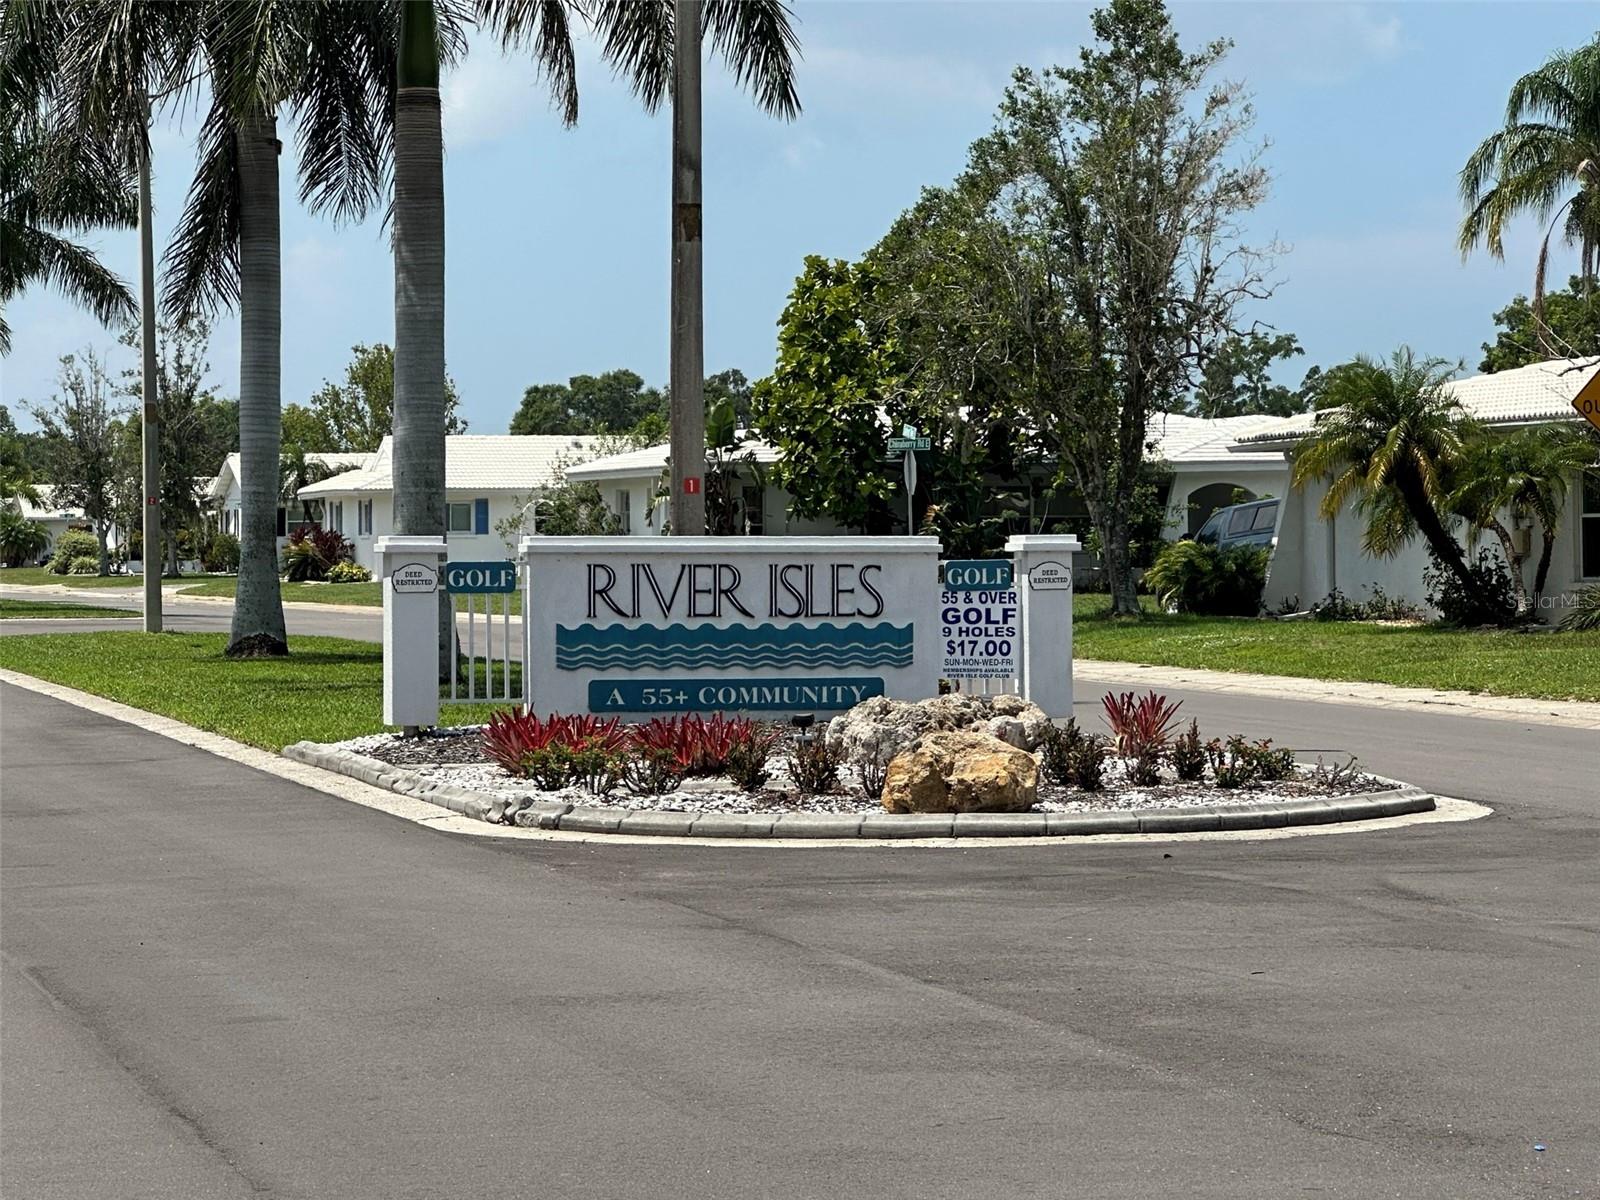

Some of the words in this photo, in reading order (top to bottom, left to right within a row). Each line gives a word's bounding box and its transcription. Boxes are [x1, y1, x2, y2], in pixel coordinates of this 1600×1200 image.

[689, 479, 694, 493] 1
[404, 571, 423, 579] DEED
[448, 569, 514, 587] GOLF
[947, 567, 1009, 585] GOLF
[1033, 576, 1069, 584] RESTRICTED
[586, 563, 755, 619] RIVER
[768, 563, 884, 618] ISLES
[941, 591, 959, 604] 55
[963, 591, 974, 604] &
[978, 591, 1017, 604] OVER
[941, 607, 1017, 625] GOLF
[942, 626, 952, 637] 9
[958, 626, 1016, 637] HOLES
[946, 639, 1012, 657] $17.00
[944, 658, 1014, 666] SUN-MON-WED-FRI
[605, 687, 626, 705] A
[641, 688, 689, 705] 55+
[698, 685, 867, 704] COMMUNITY
